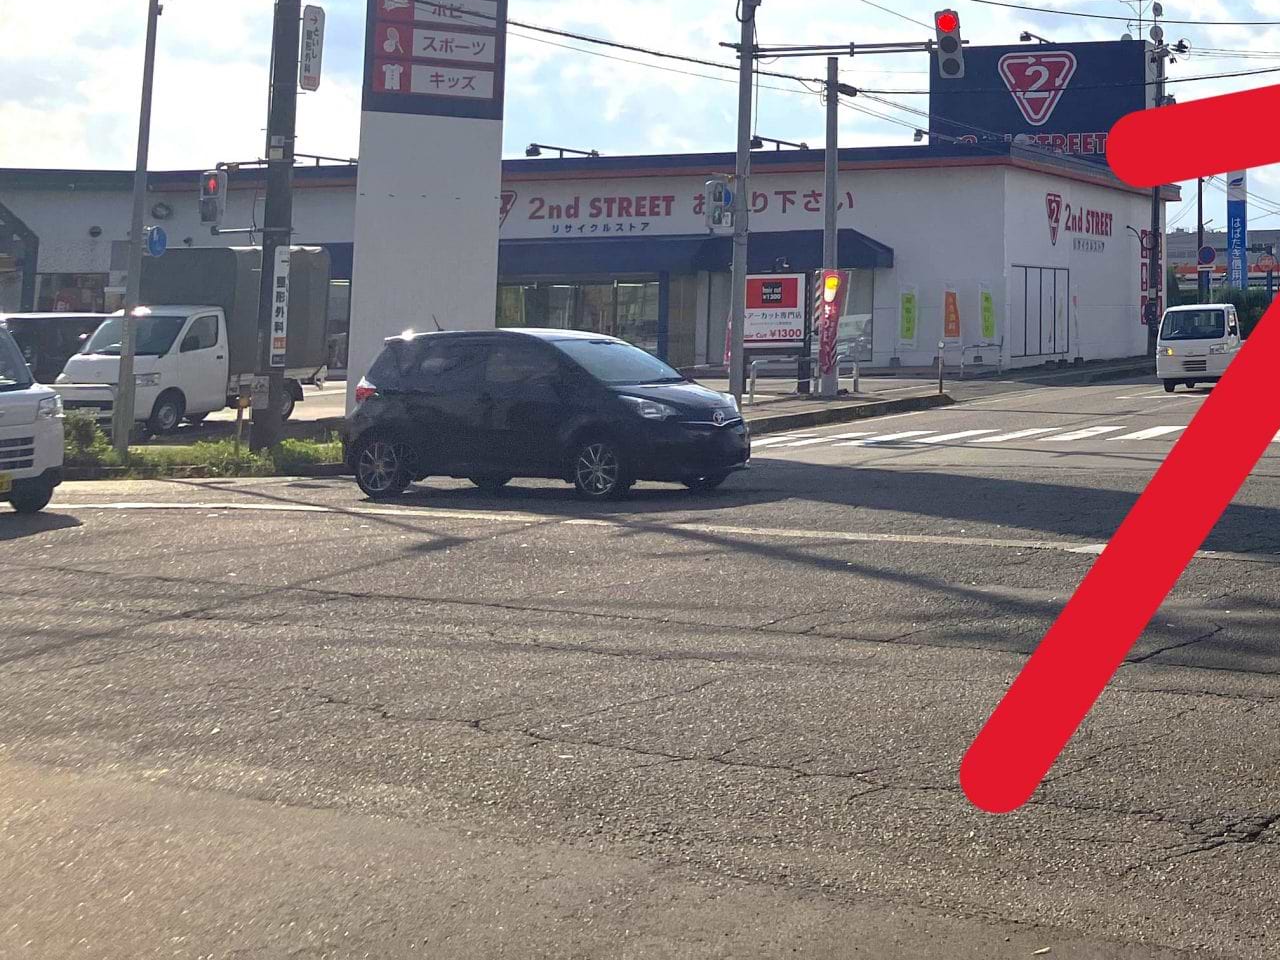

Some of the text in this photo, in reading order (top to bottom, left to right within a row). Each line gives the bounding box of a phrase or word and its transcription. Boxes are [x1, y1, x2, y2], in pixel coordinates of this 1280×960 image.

[423, 36, 486, 56] スポーツ
[430, 71, 477, 91] キッズ
[1030, 132, 1108, 155] TREET
[528, 190, 854, 220] 2nd STREET おり下さい
[552, 222, 650, 233] リサイクルストア
[1064, 203, 1113, 237] 2nd STREET
[770, 329, 802, 337] ¥1300
